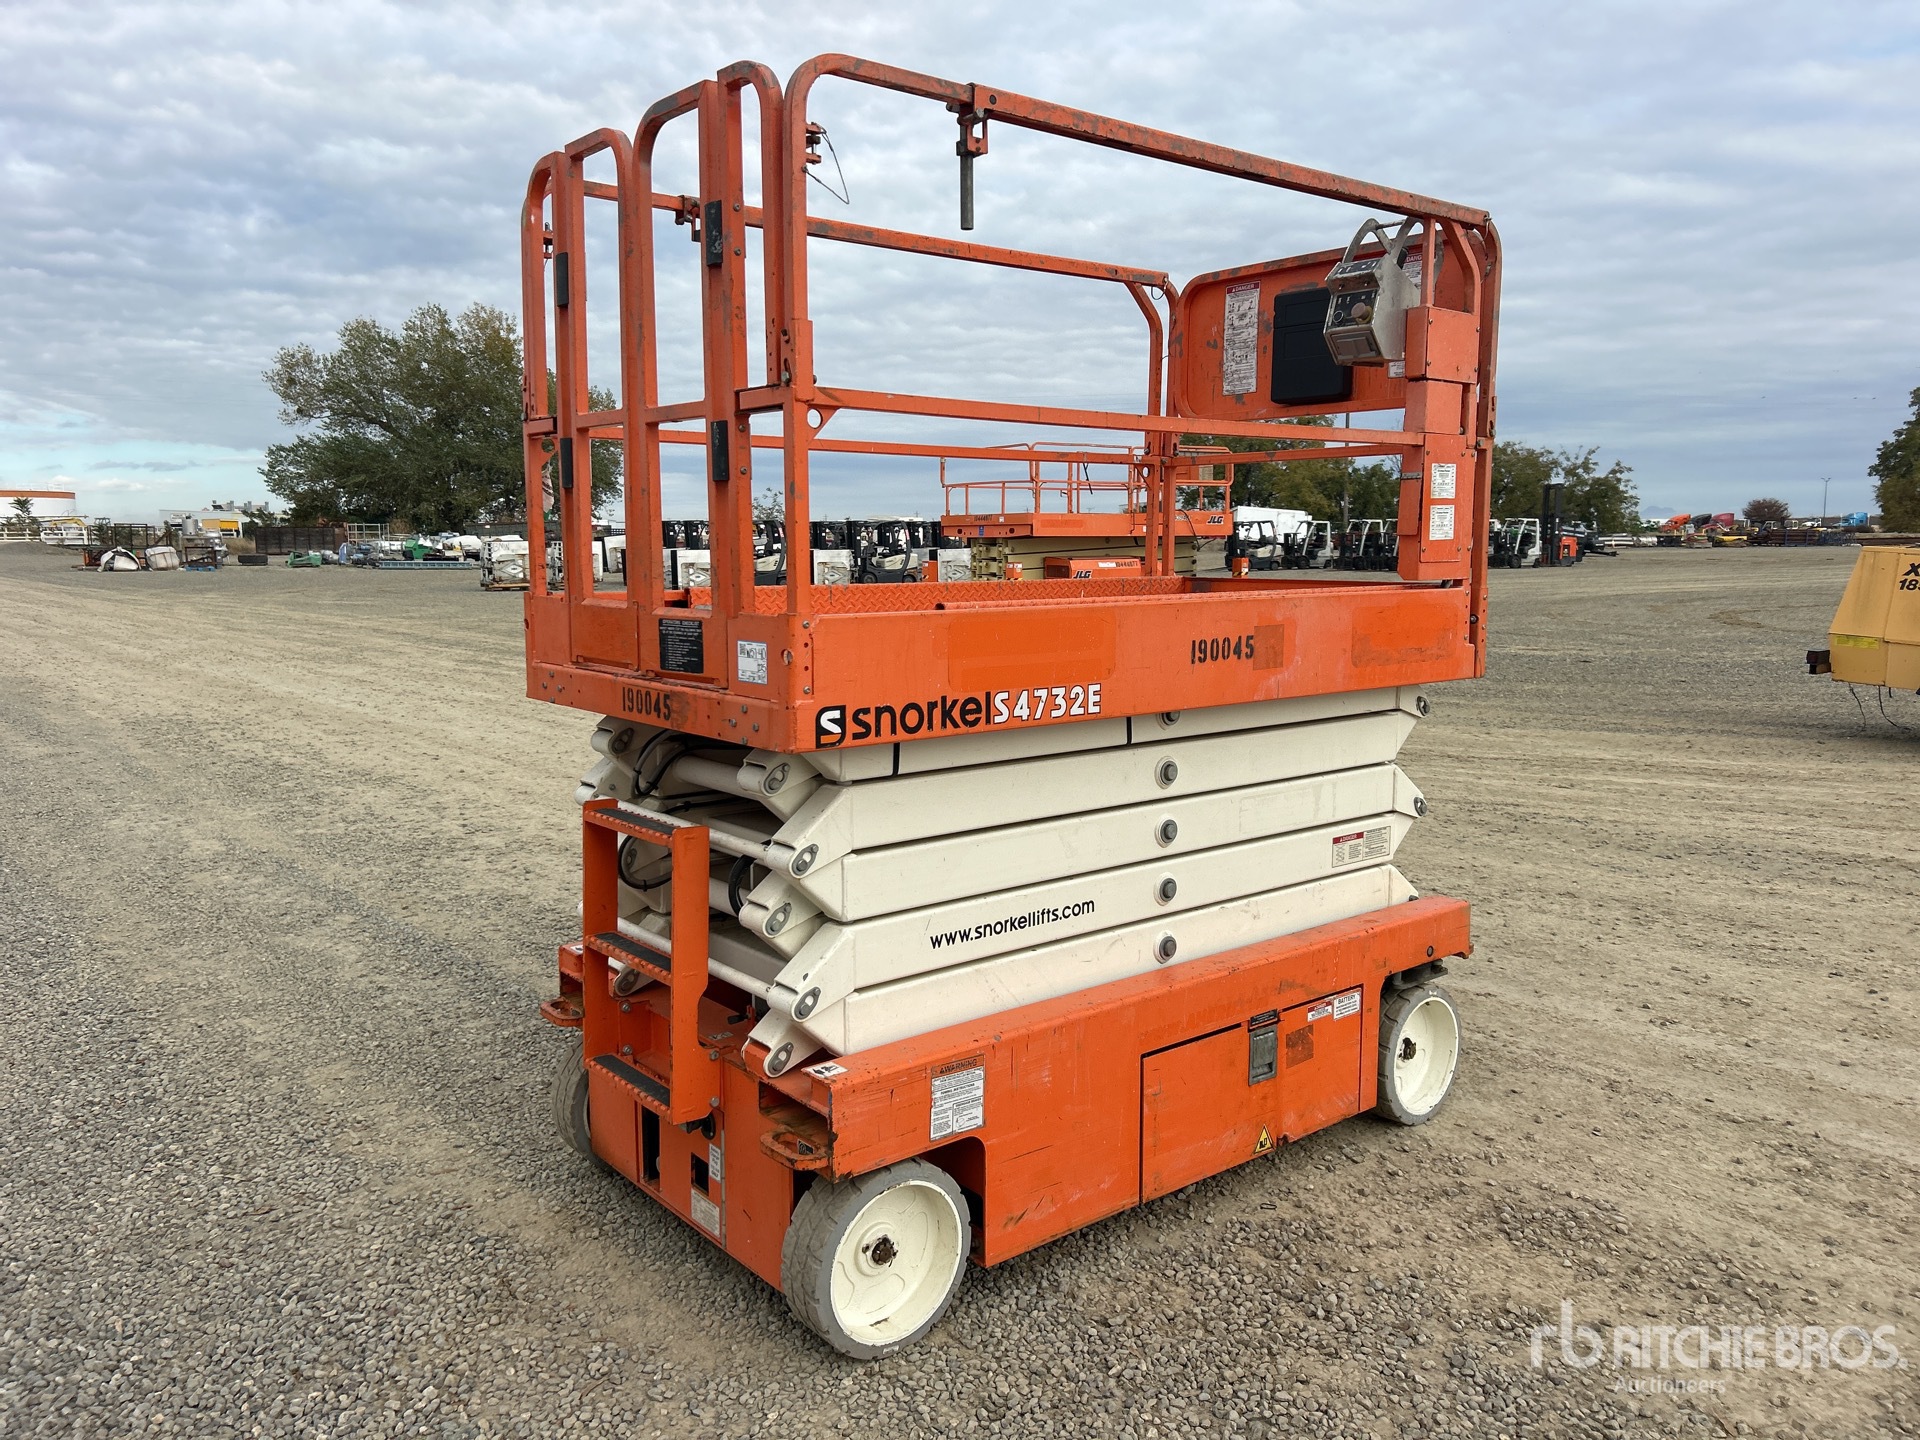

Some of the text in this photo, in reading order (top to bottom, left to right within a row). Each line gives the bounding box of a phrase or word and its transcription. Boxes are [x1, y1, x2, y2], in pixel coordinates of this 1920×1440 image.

[1207, 515, 1224, 524] JLG
[1072, 570, 1092, 579] JLG
[1899, 578, 1920, 590] 18
[1191, 635, 1254, 664] 190045
[622, 686, 671, 721] 190045
[852, 691, 991, 740] snorkel
[993, 683, 1101, 724] S4732E
[930, 900, 1095, 949] www.snorkellifts.com
[1337, 994, 1356, 1005] BATTERY
